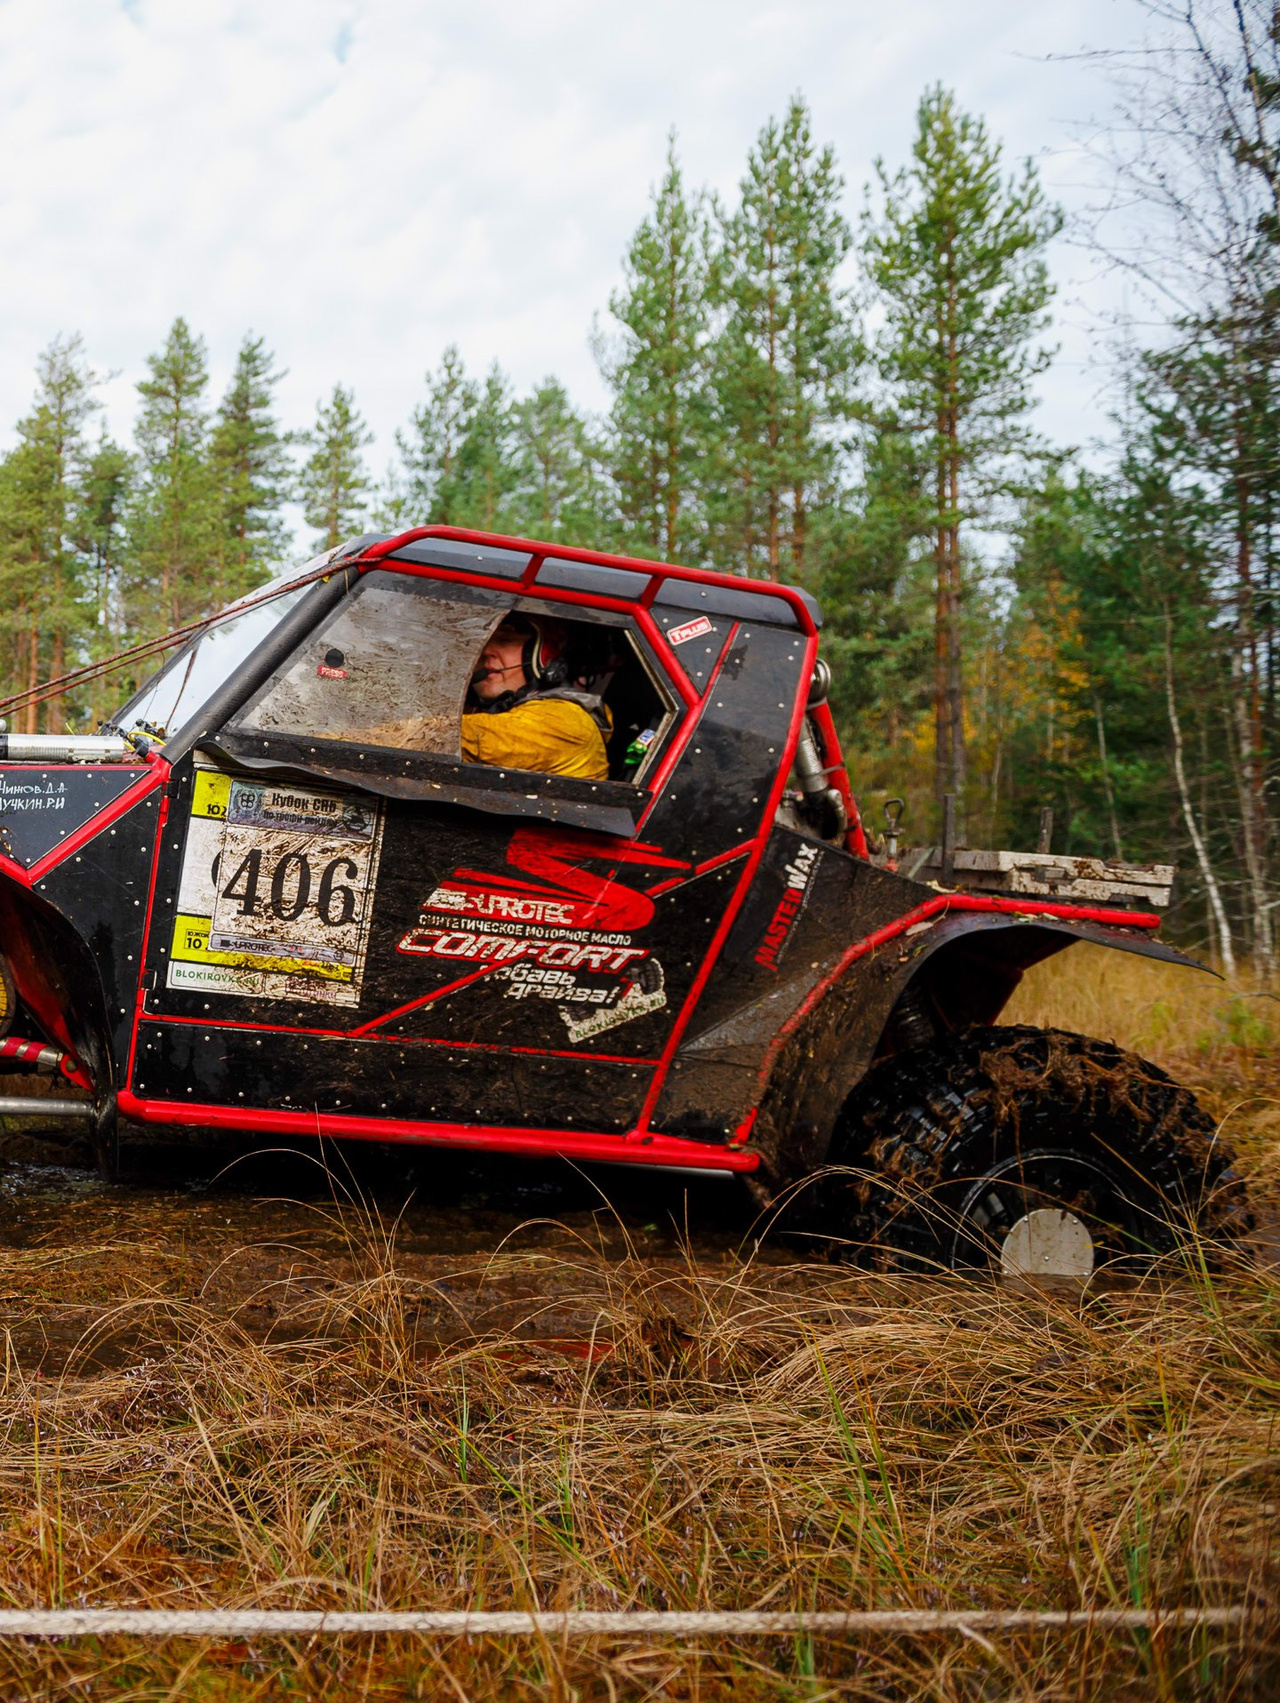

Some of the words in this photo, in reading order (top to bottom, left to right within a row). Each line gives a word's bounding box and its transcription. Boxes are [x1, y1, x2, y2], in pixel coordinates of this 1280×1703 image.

[221, 848, 359, 927] 406
[398, 927, 647, 970] COMFORT
[590, 933, 632, 947] МАСЛО
